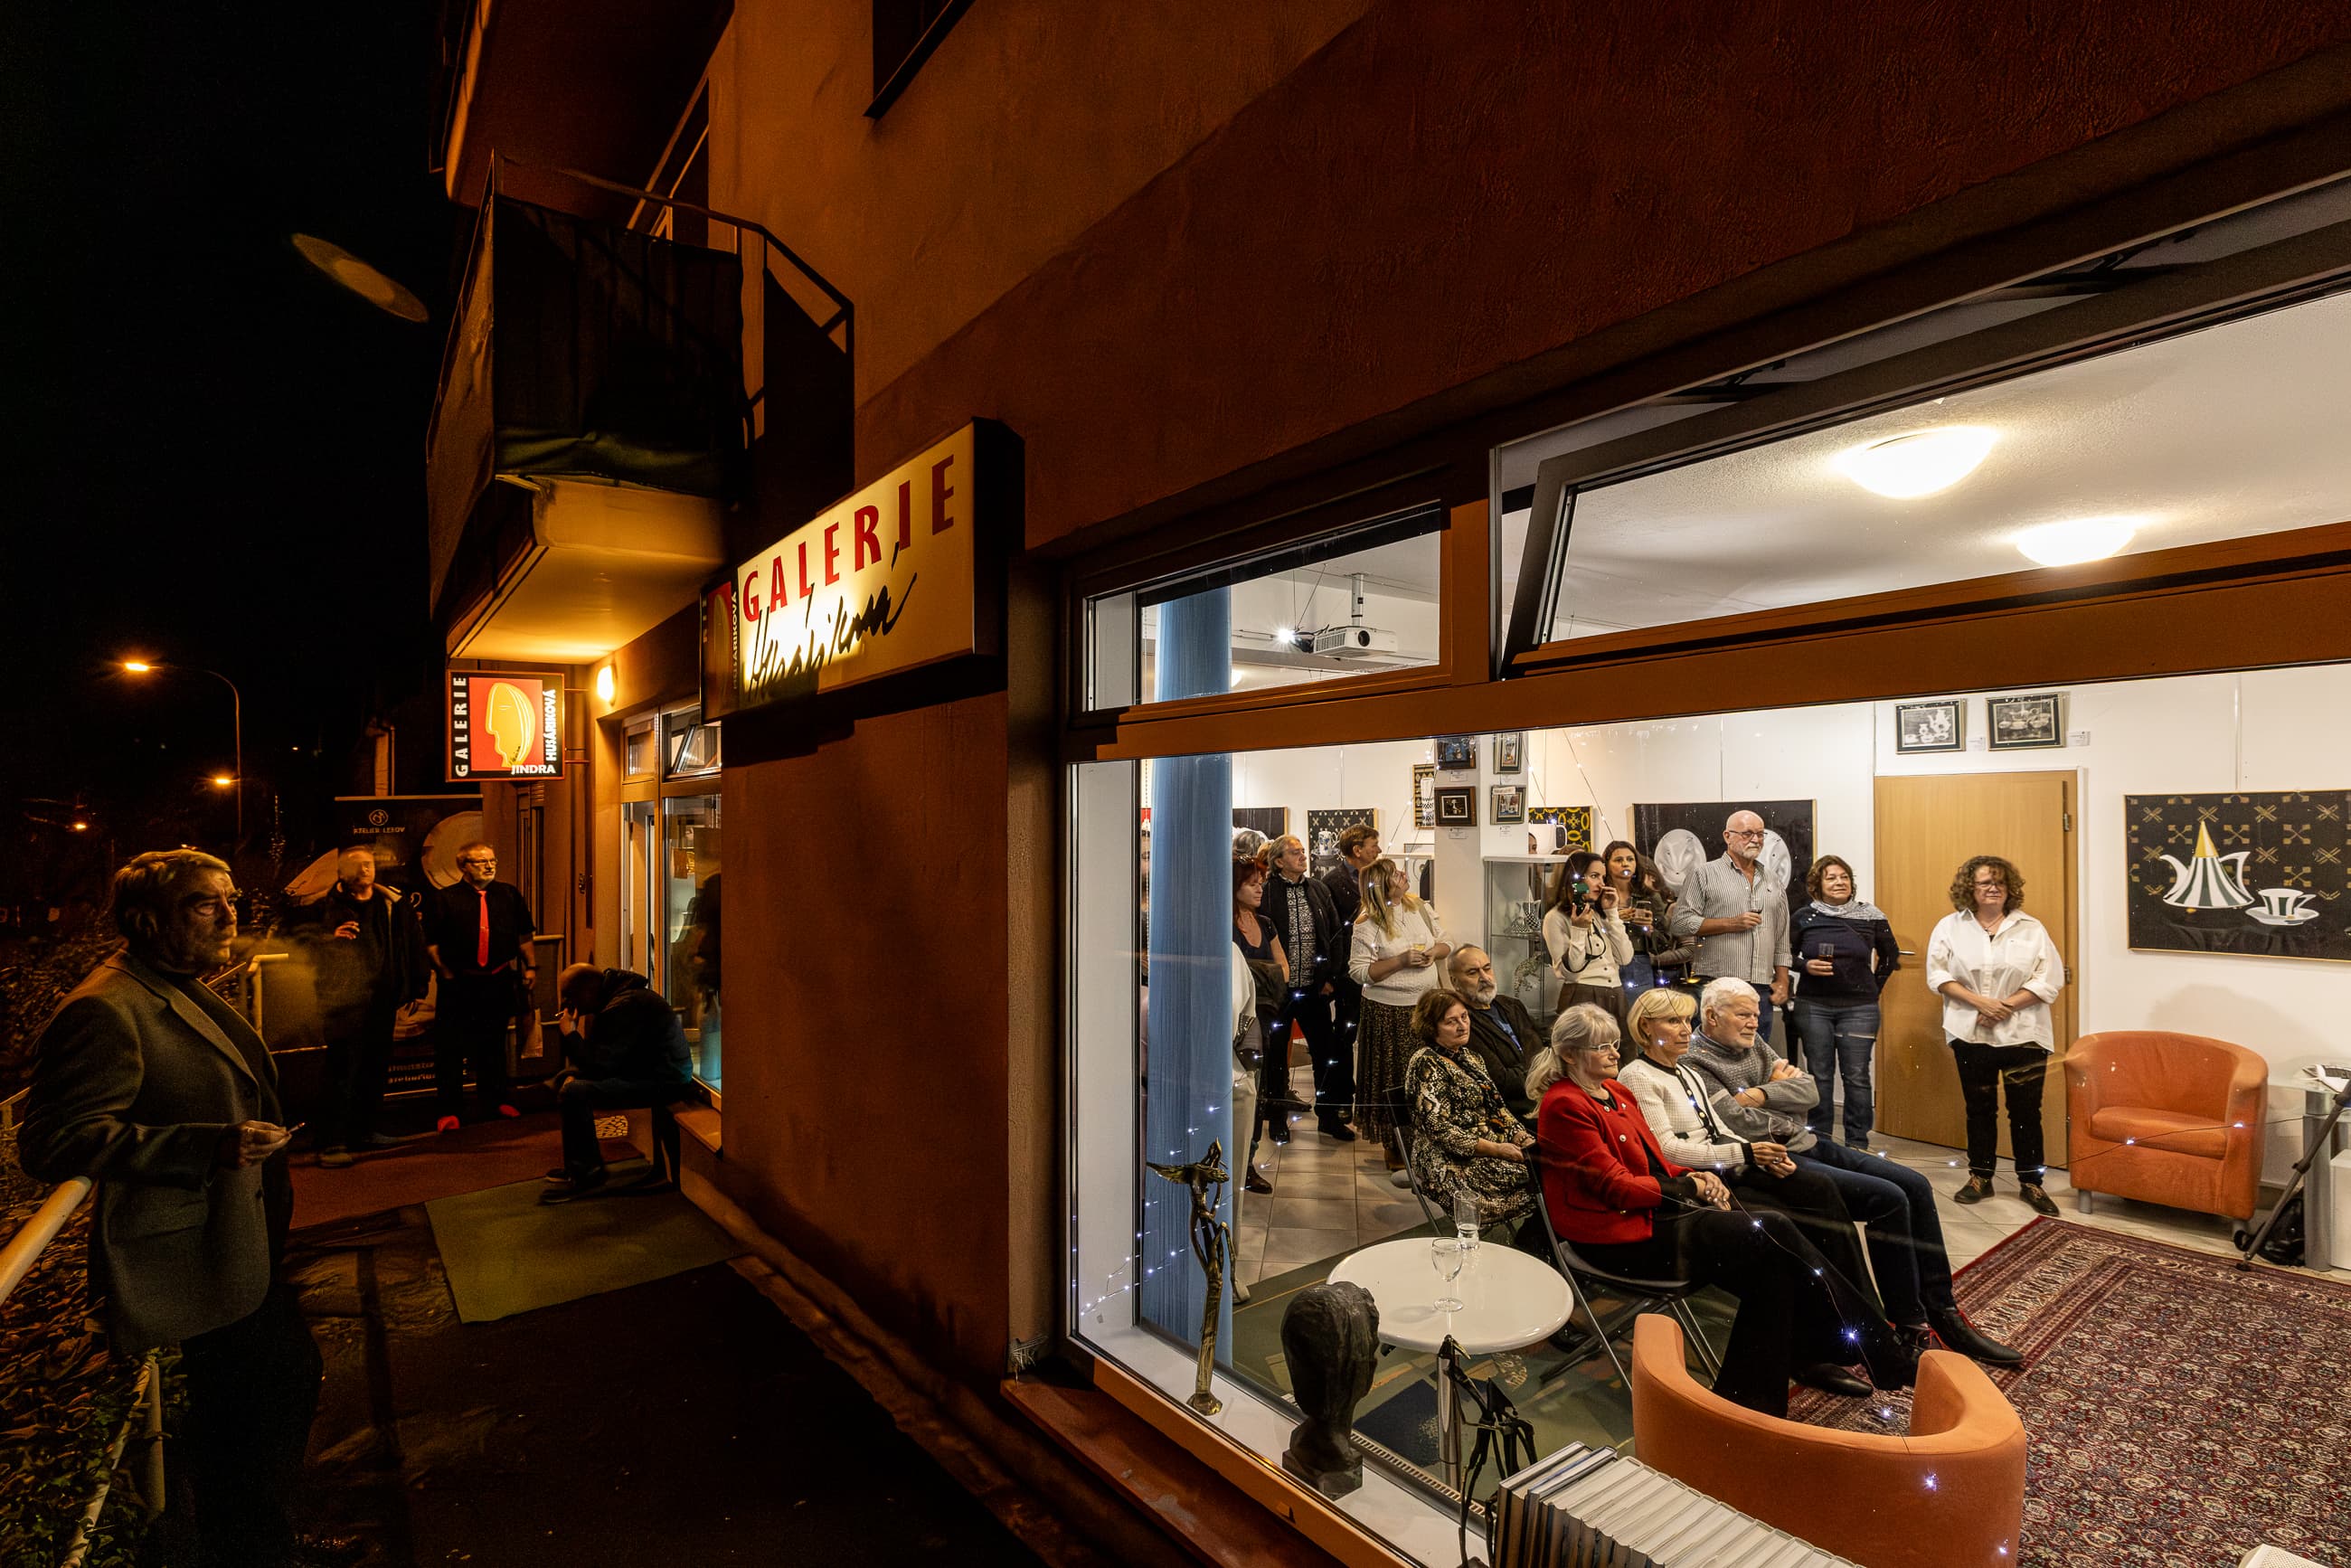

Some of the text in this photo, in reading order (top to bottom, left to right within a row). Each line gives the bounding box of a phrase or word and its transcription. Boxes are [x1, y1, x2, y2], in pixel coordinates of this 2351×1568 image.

[743, 454, 955, 622] GALERIE
[453, 676, 469, 778] GALERIE
[543, 689, 557, 761] HUSÁRIKOVÁ
[511, 764, 557, 775] JINDRA
